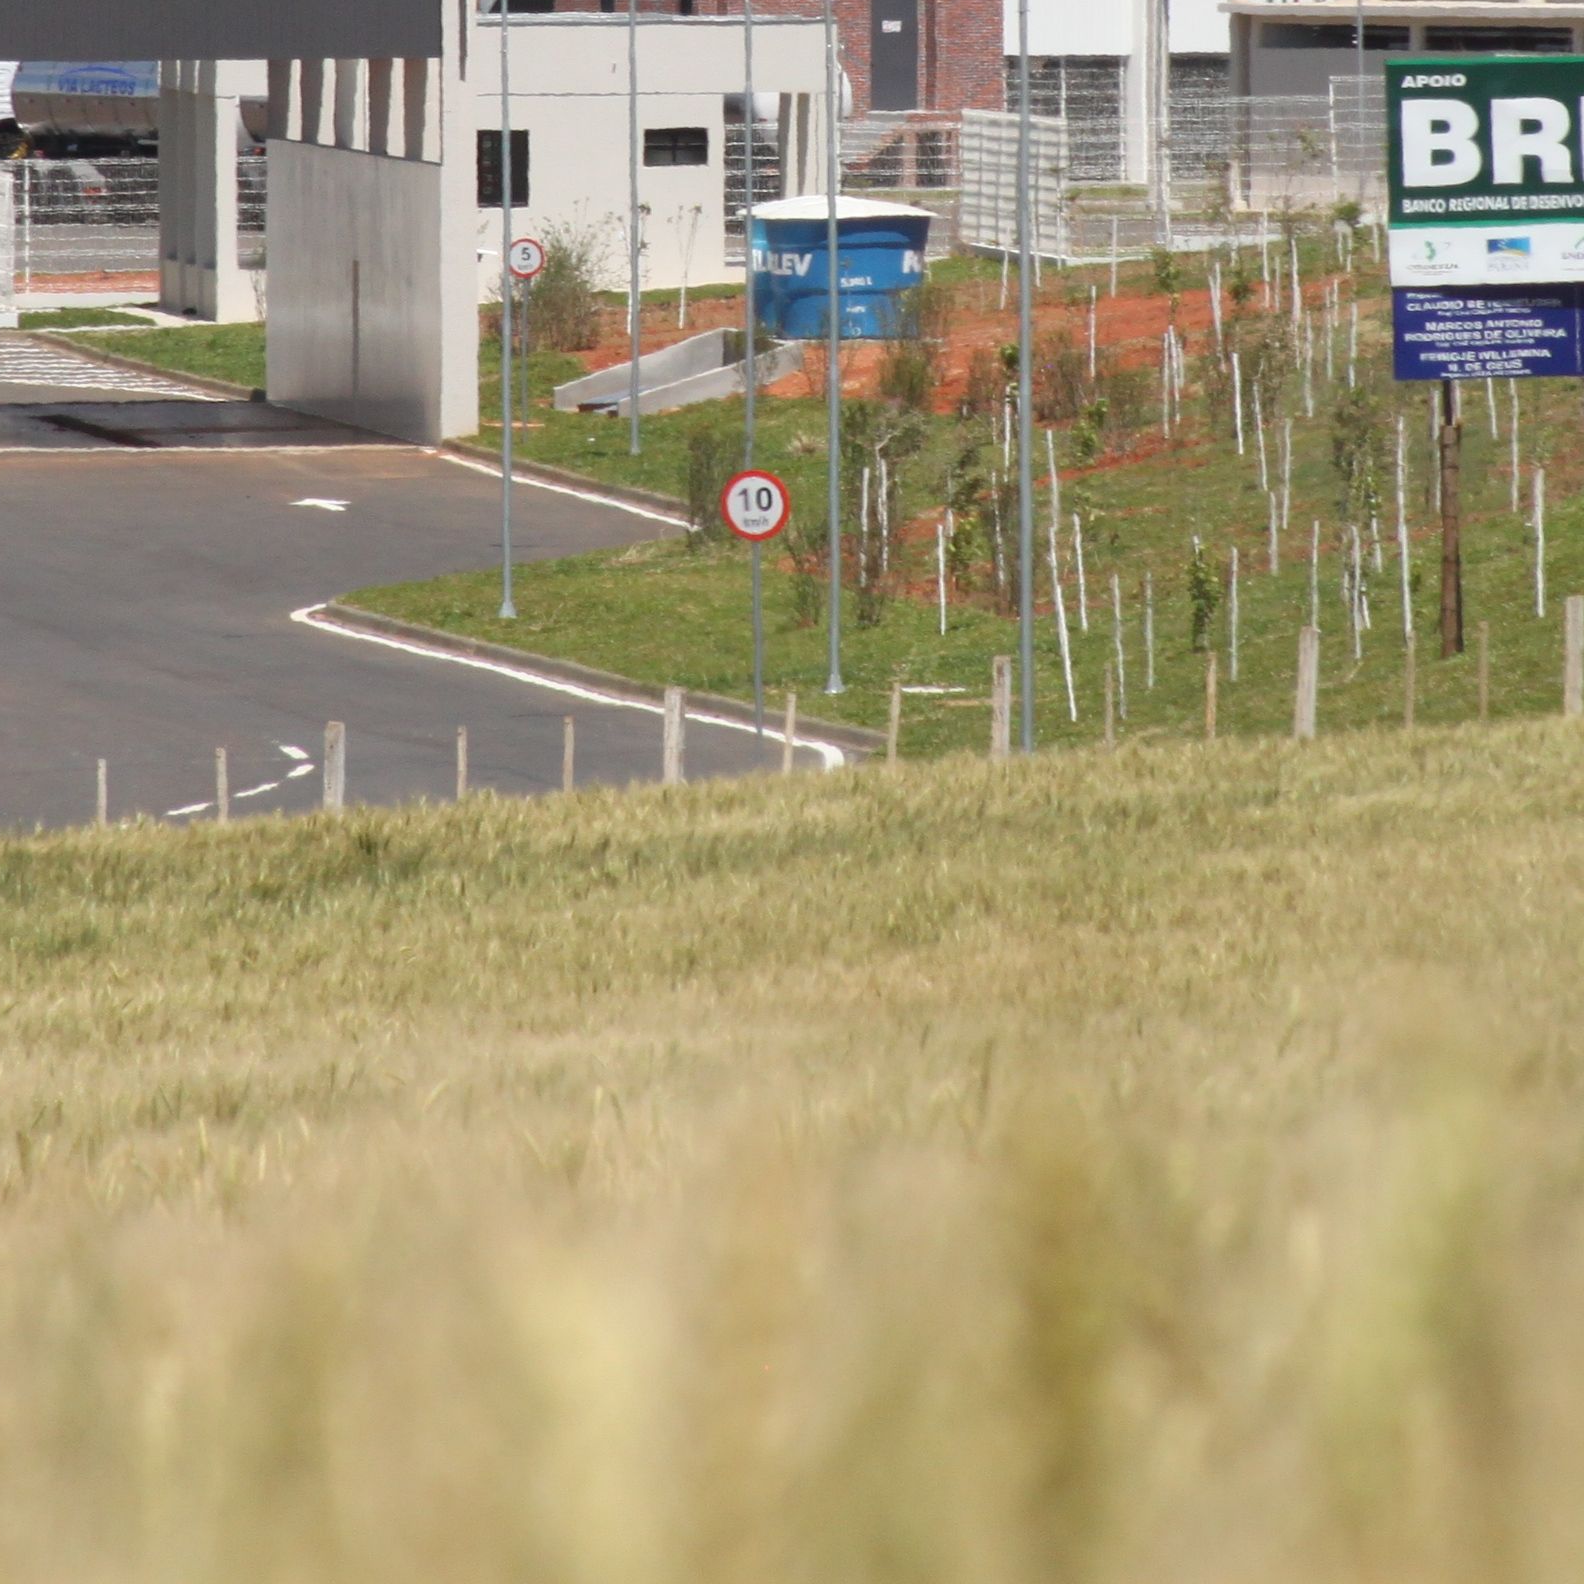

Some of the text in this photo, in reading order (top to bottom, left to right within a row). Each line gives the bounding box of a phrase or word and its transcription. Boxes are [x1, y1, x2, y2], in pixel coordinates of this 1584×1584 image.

[1401, 73, 1467, 89] APOIO
[1402, 198, 1445, 213] BANCO
[1449, 196, 1510, 212] REGIONAL
[1512, 197, 1529, 211] DE
[521, 247, 531, 261] 5
[1406, 300, 1464, 312] CLAUDIO
[1425, 319, 1544, 332] MARCOS ANTONIO
[1404, 331, 1481, 343] RODRIGUES
[1484, 330, 1504, 341] DE
[1505, 328, 1568, 340] OLIVEIRA
[737, 487, 773, 512] 10
